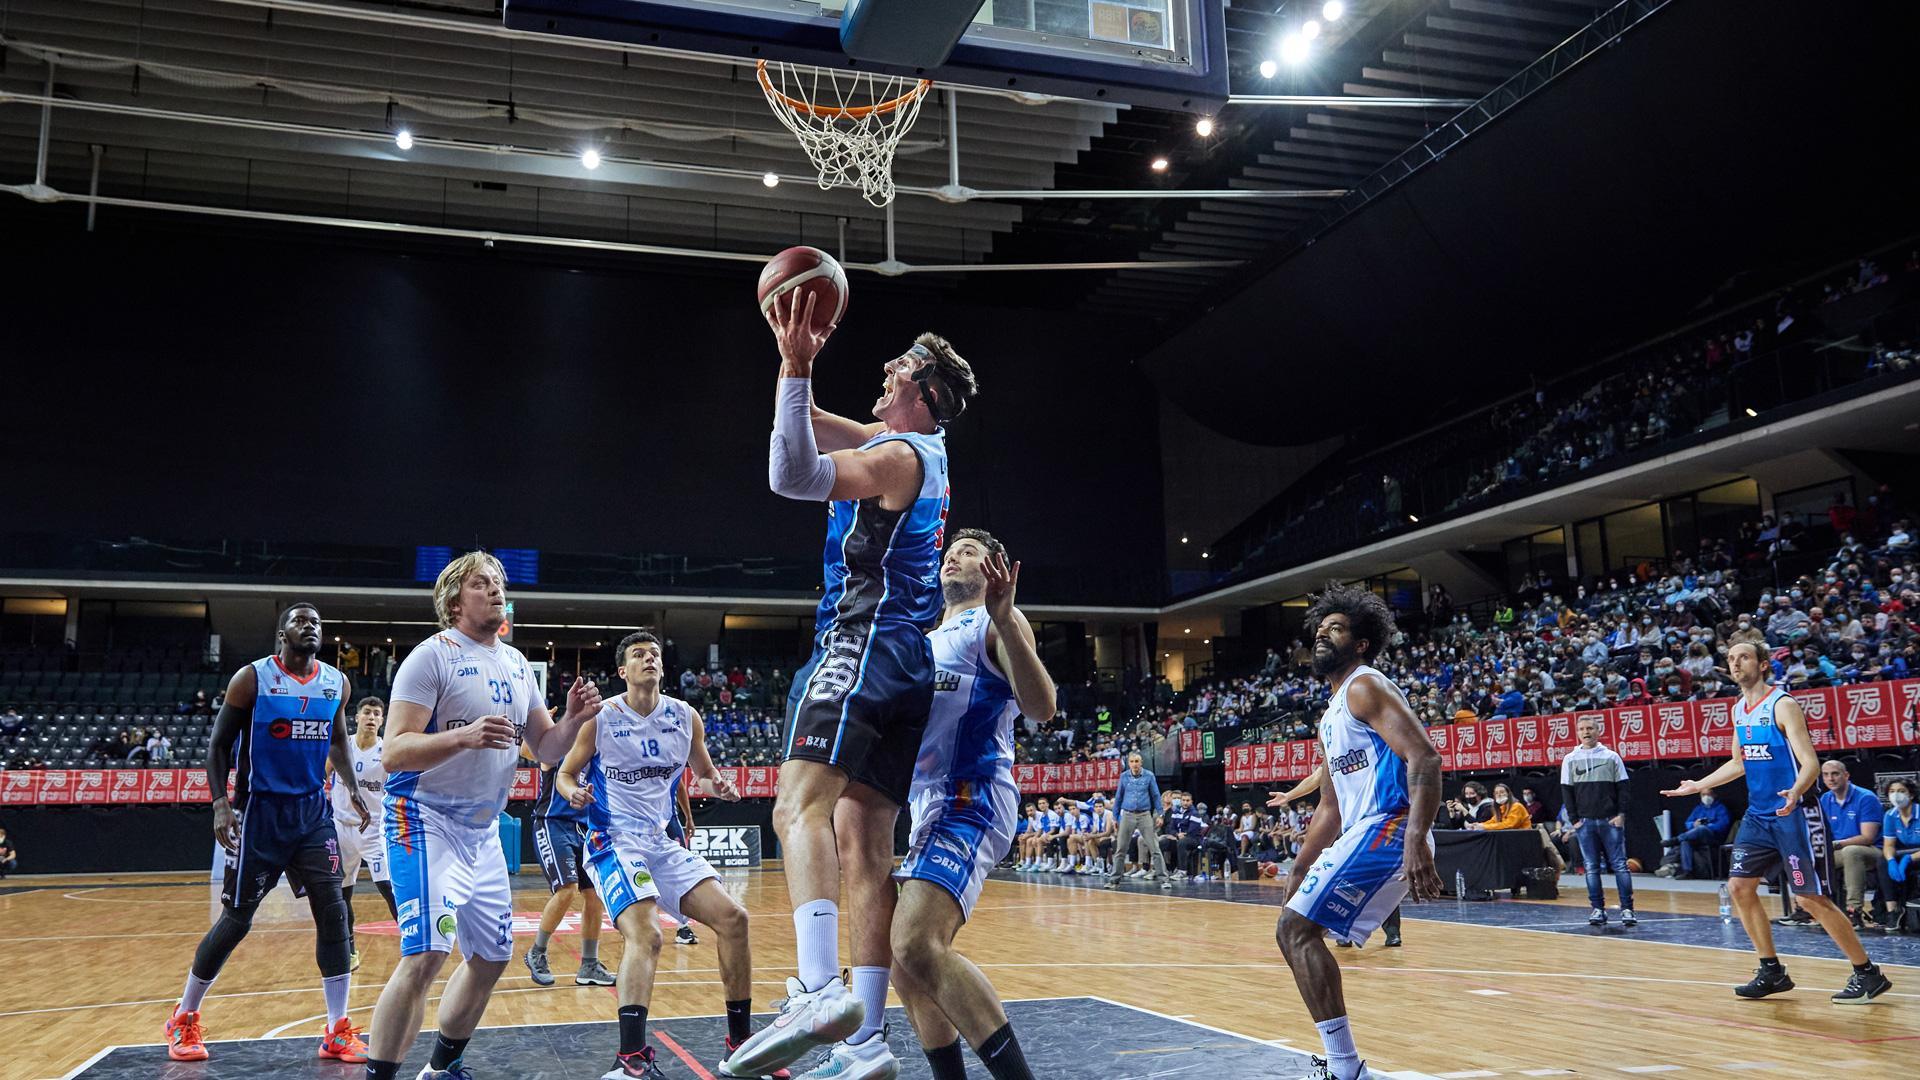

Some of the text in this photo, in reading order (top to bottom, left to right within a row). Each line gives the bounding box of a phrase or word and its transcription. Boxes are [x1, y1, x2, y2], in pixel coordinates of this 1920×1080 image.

[464, 667, 479, 676] BZK
[489, 679, 512, 704] 33
[298, 696, 309, 714] 7
[1846, 688, 1881, 724] 75
[292, 720, 330, 736] BZK
[1619, 711, 1644, 740] 75
[1659, 707, 1685, 737] 75
[1701, 703, 1729, 735] 75
[1430, 729, 1447, 750] 75
[1457, 726, 1475, 752] 75
[1486, 724, 1506, 750] 75
[1516, 721, 1537, 748] 75
[1548, 717, 1569, 746] 75
[641, 739, 660, 758] 18
[805, 735, 828, 749] BZK
[1272, 745, 1285, 766] 75
[1292, 743, 1305, 765] 75
[356, 761, 363, 773] 0
[1017, 766, 1034, 782] 75
[6, 773, 31, 791] 75
[42, 772, 67, 790] 75
[78, 772, 102, 790] 75
[114, 772, 138, 790] 75
[149, 771, 173, 790] 75
[184, 771, 207, 789] 75
[512, 770, 531, 787] 75
[748, 769, 766, 786] 75
[690, 828, 748, 850] BZK
[1802, 806, 1825, 858] CBVE
[328, 855, 339, 874] 7
[373, 862, 380, 873] 0
[941, 856, 961, 875] BZK
[1792, 870, 1805, 886] 9
